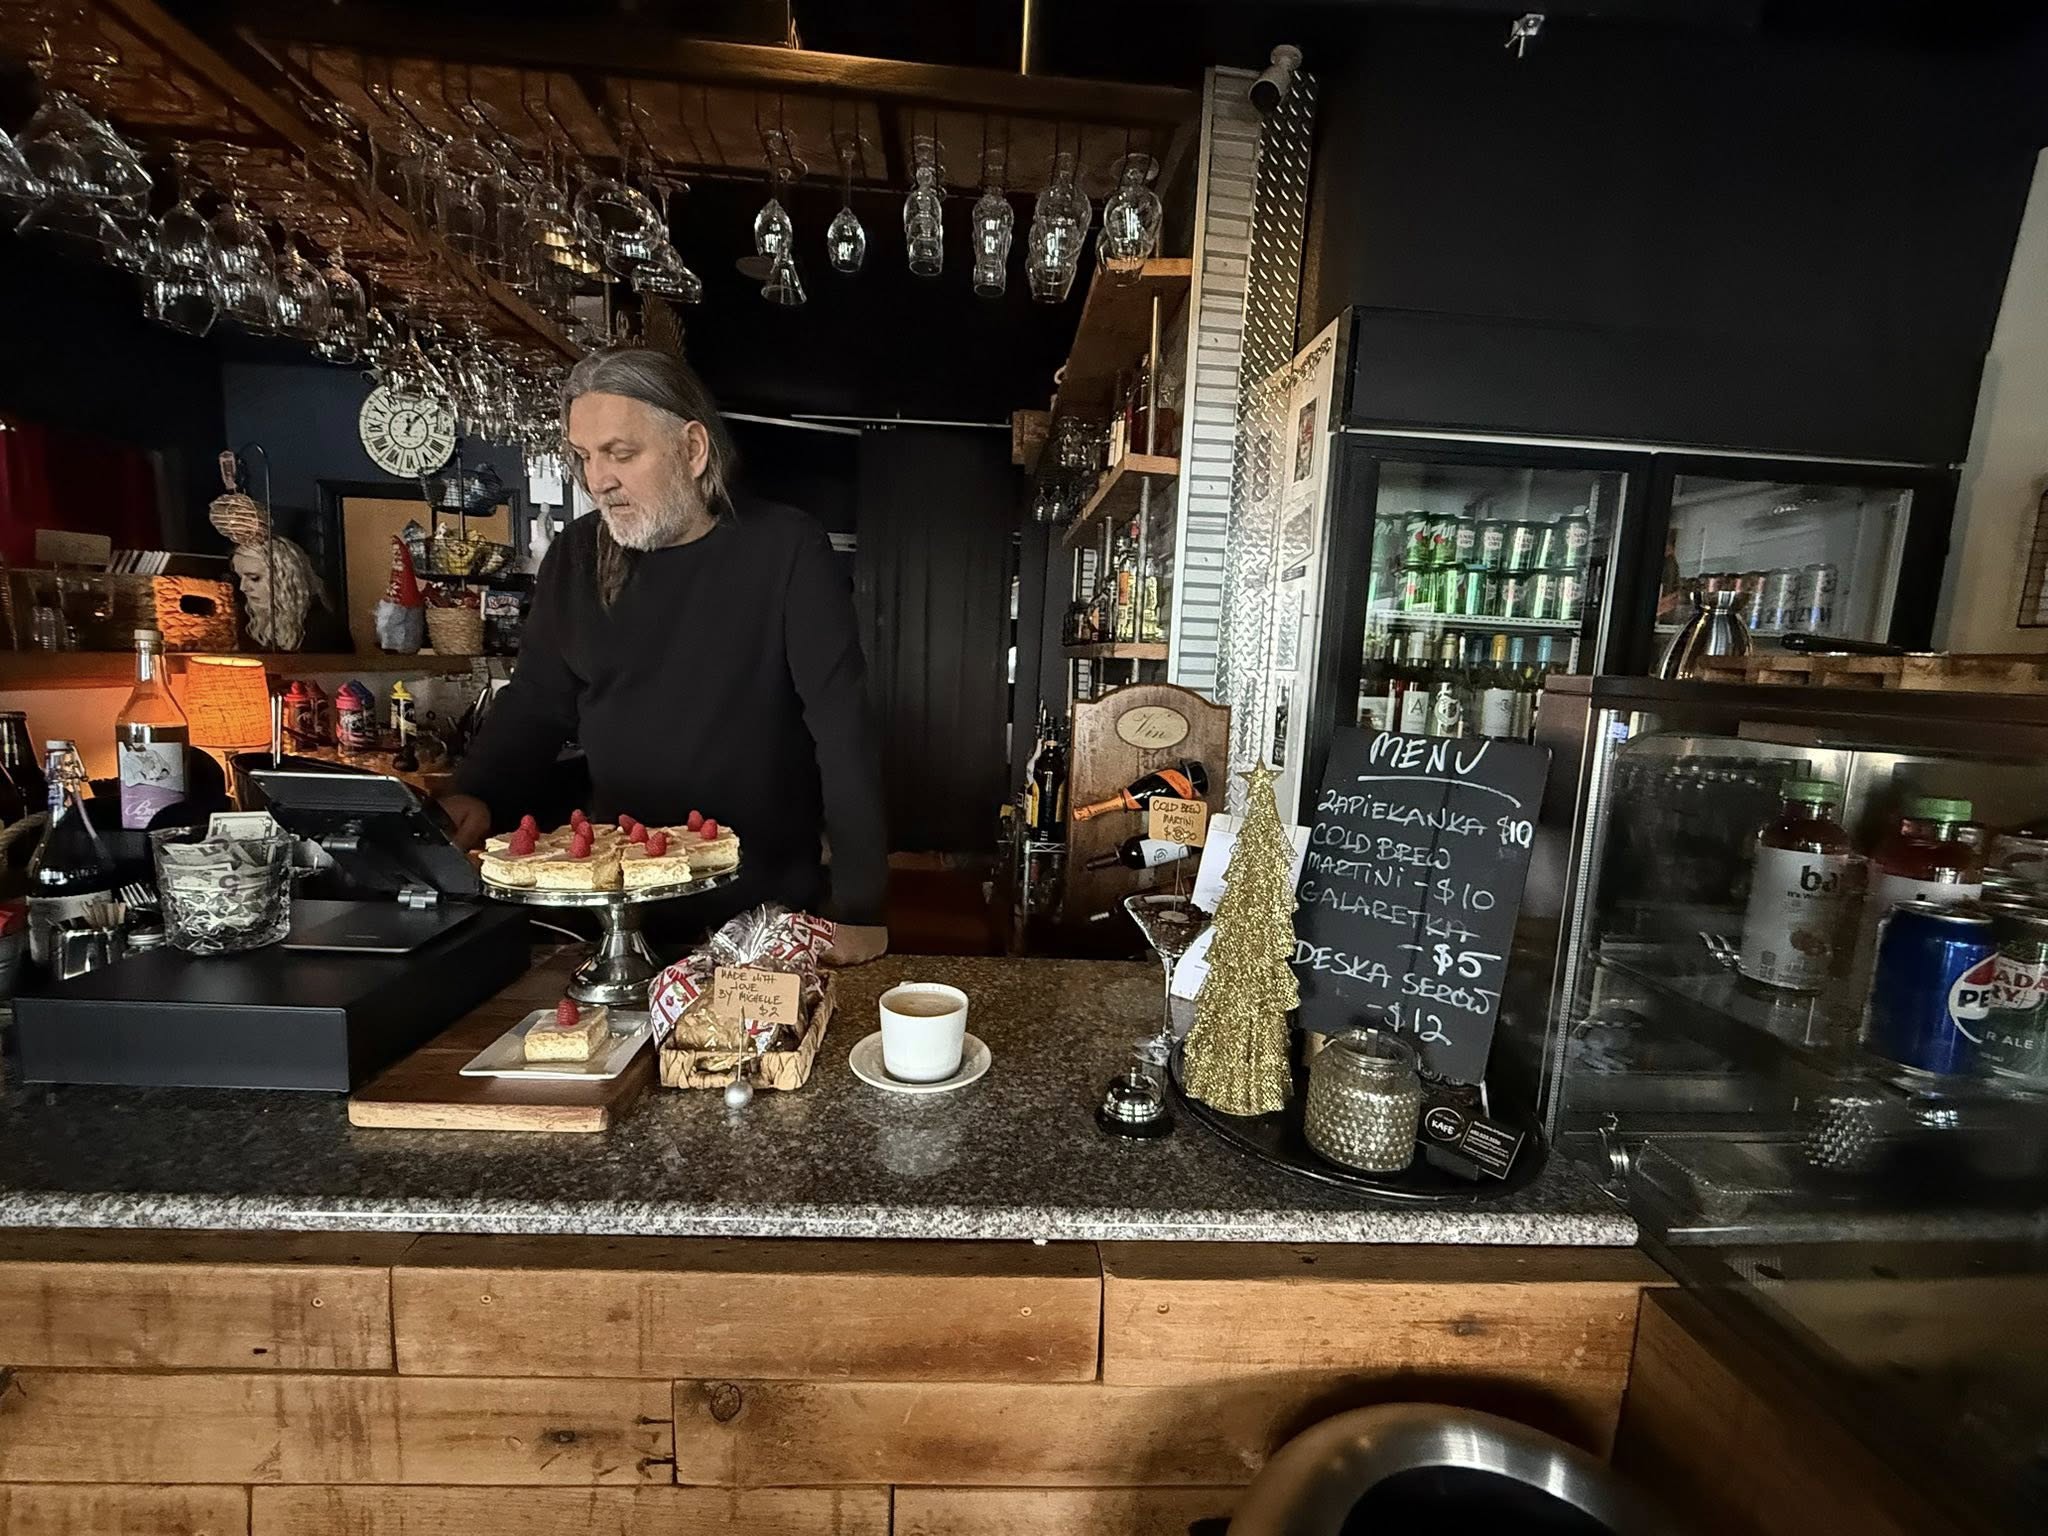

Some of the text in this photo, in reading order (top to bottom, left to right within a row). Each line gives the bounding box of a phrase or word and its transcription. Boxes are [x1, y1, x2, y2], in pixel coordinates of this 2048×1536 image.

[1370, 732, 1490, 775] MENU
[1153, 800, 1202, 815] COLD BREW
[1312, 822, 1451, 869] COLD BREW
[1497, 816, 1533, 848] $10
[1307, 852, 1404, 888] MARTINI
[1300, 881, 1481, 942] GALARETKA
[721, 969, 748, 981] MADE
[1292, 940, 1393, 988] DESKA
[718, 988, 733, 1006] BY
[730, 982, 759, 992] LOVE
[1431, 1119, 1456, 1135] KAFE
